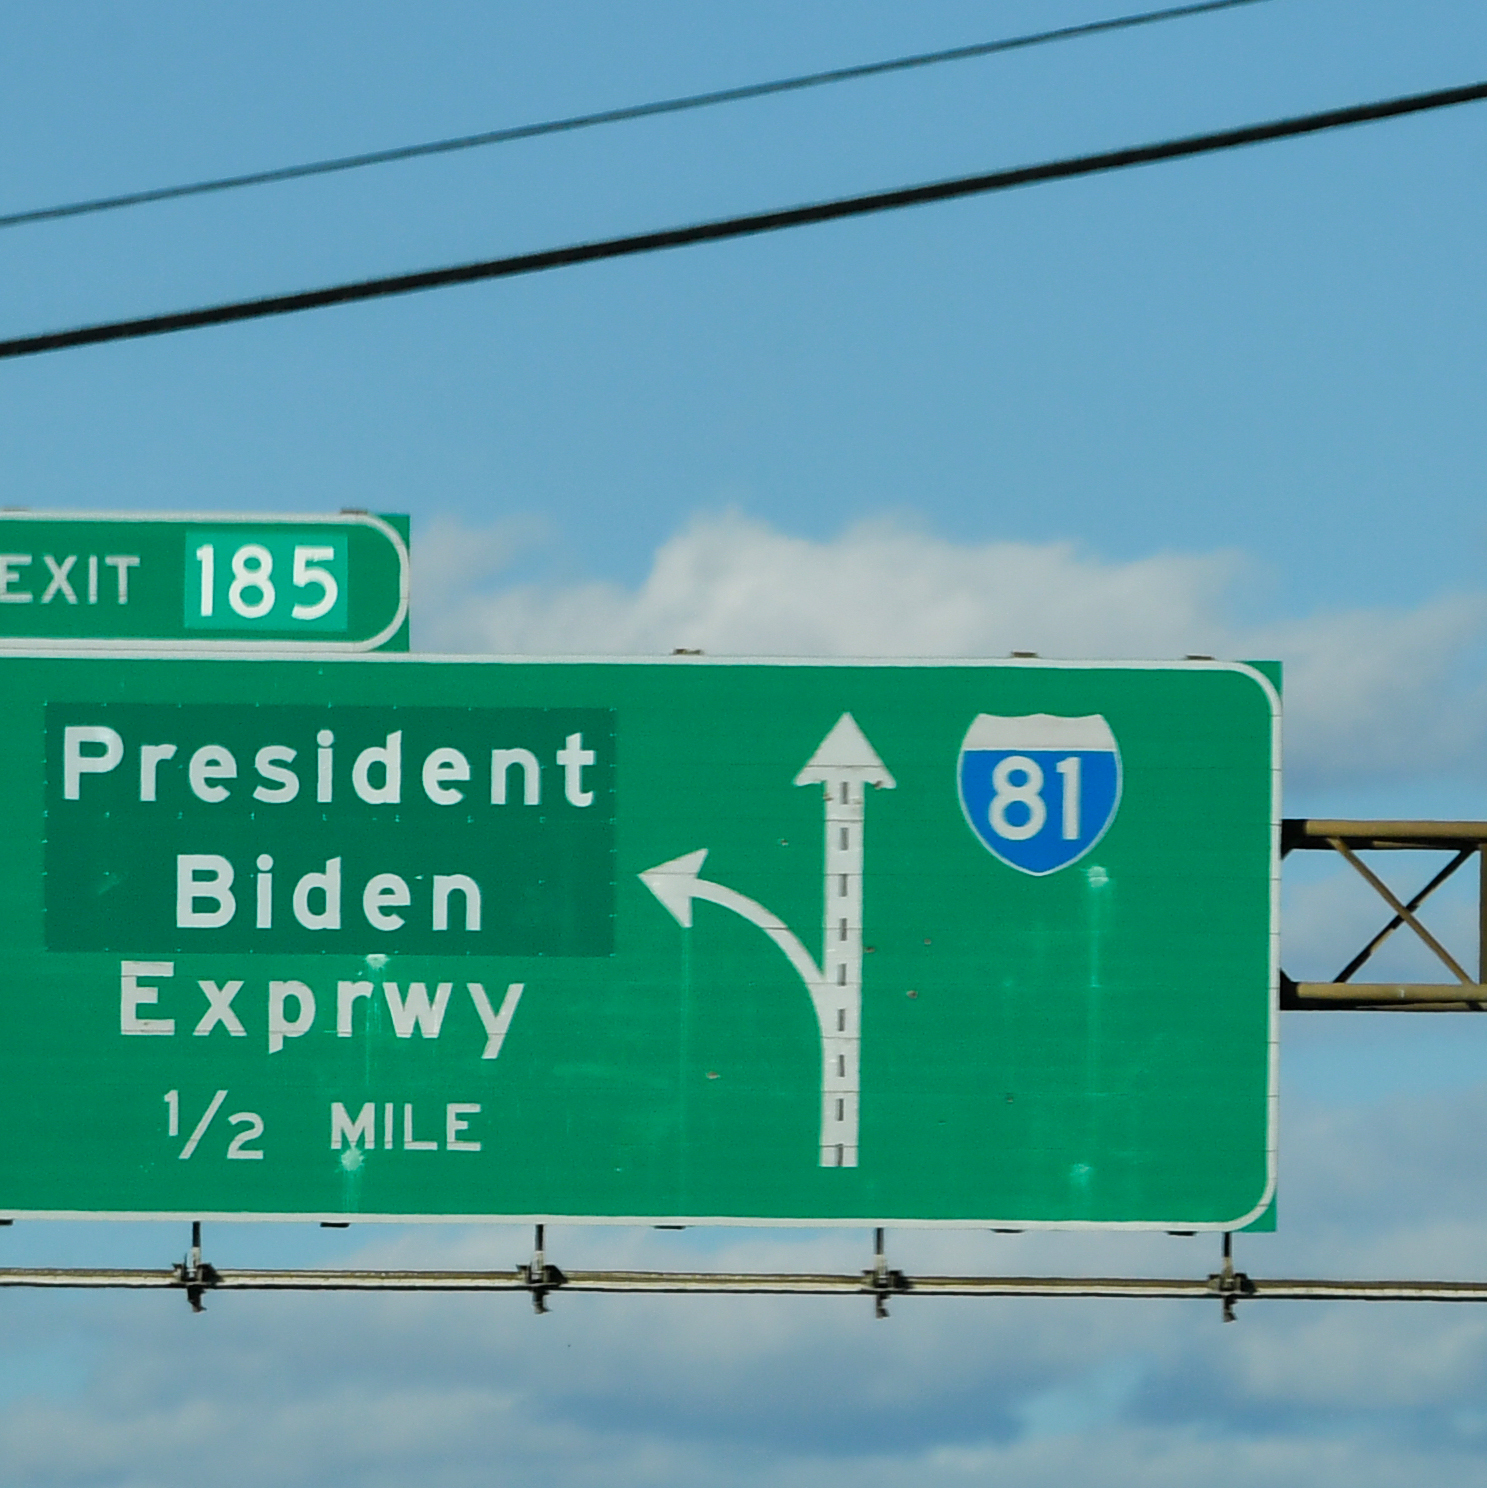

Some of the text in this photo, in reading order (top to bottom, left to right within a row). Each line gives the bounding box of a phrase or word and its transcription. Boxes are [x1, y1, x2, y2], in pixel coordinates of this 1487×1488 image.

[196, 544, 341, 621] 185
[61, 725, 599, 807] President
[987, 756, 1082, 841] 81
[176, 853, 482, 932] Biden
[118, 960, 525, 1060] Exprwy
[163, 1089, 482, 1160] 1/2 MILE
